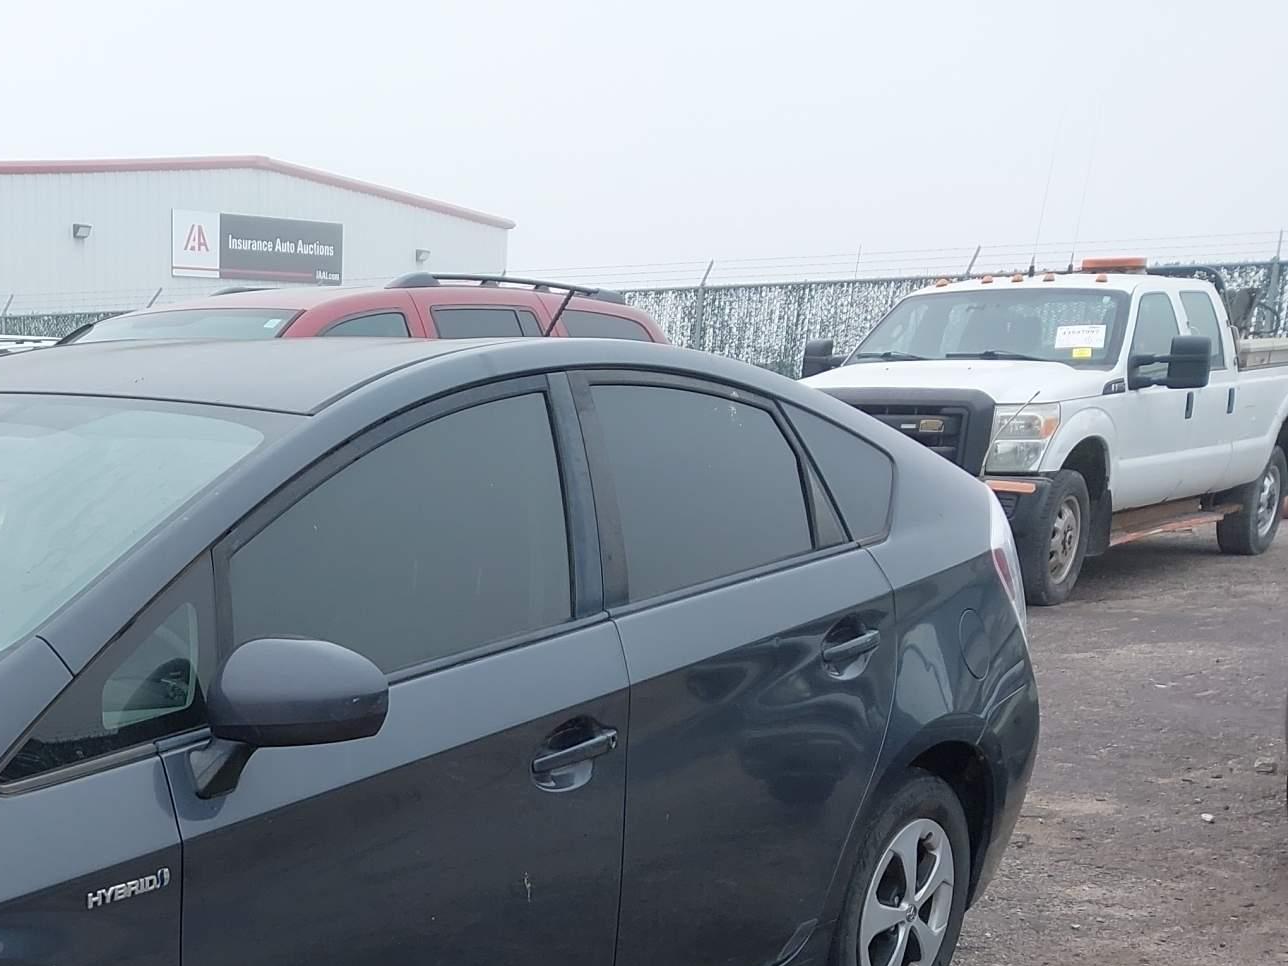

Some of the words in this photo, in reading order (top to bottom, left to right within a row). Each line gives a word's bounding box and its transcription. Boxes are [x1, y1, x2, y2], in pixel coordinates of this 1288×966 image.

[228, 234, 273, 251] Insurance
[275, 238, 295, 254] Auto
[297, 239, 334, 257] Auctions
[87, 874, 157, 909] HYBRID
